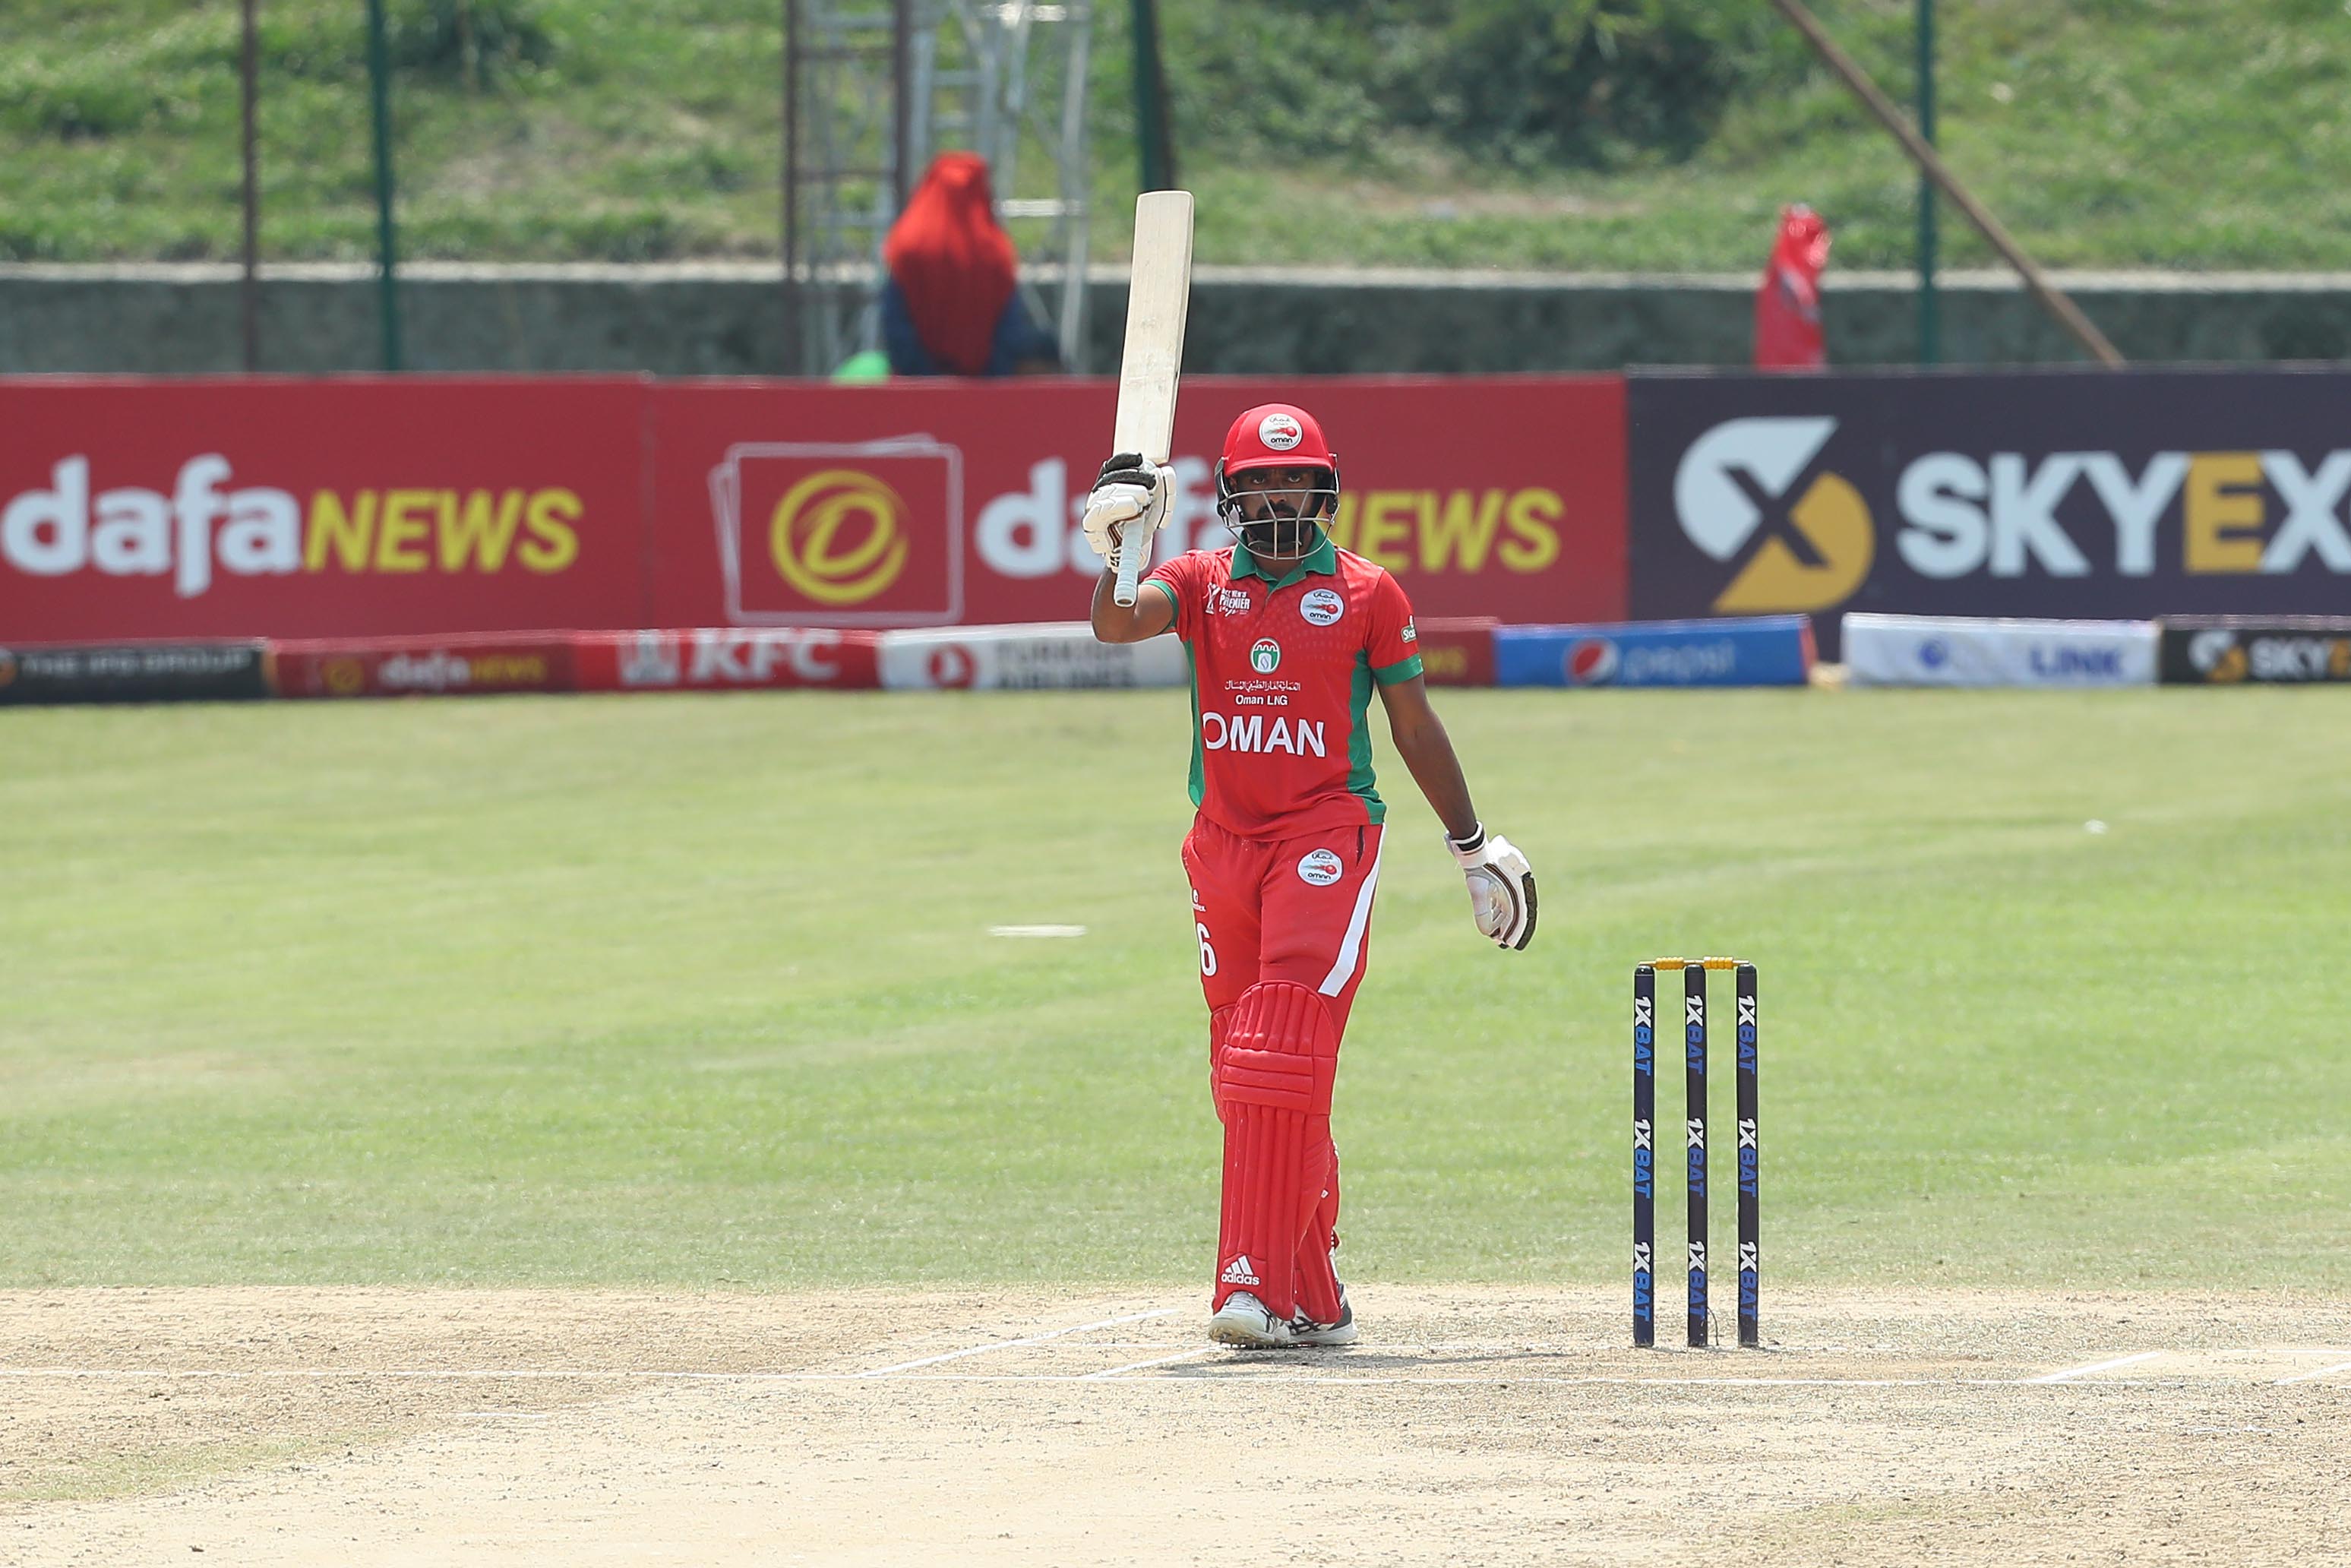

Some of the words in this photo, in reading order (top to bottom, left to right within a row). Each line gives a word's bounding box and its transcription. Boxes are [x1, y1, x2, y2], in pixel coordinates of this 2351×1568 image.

[1, 454, 584, 599] dafaNEWS
[1895, 448, 2351, 580] SKYEX
[1219, 594, 1250, 609] PREMIER
[688, 628, 841, 682] KFC
[2029, 645, 2122, 676] LINK
[1235, 694, 1264, 705] Oman
[1267, 695, 1288, 705] LNG
[1202, 712, 1326, 757] OMAN
[1196, 922, 1217, 977] 6
[1221, 1272, 1260, 1285] adidas
